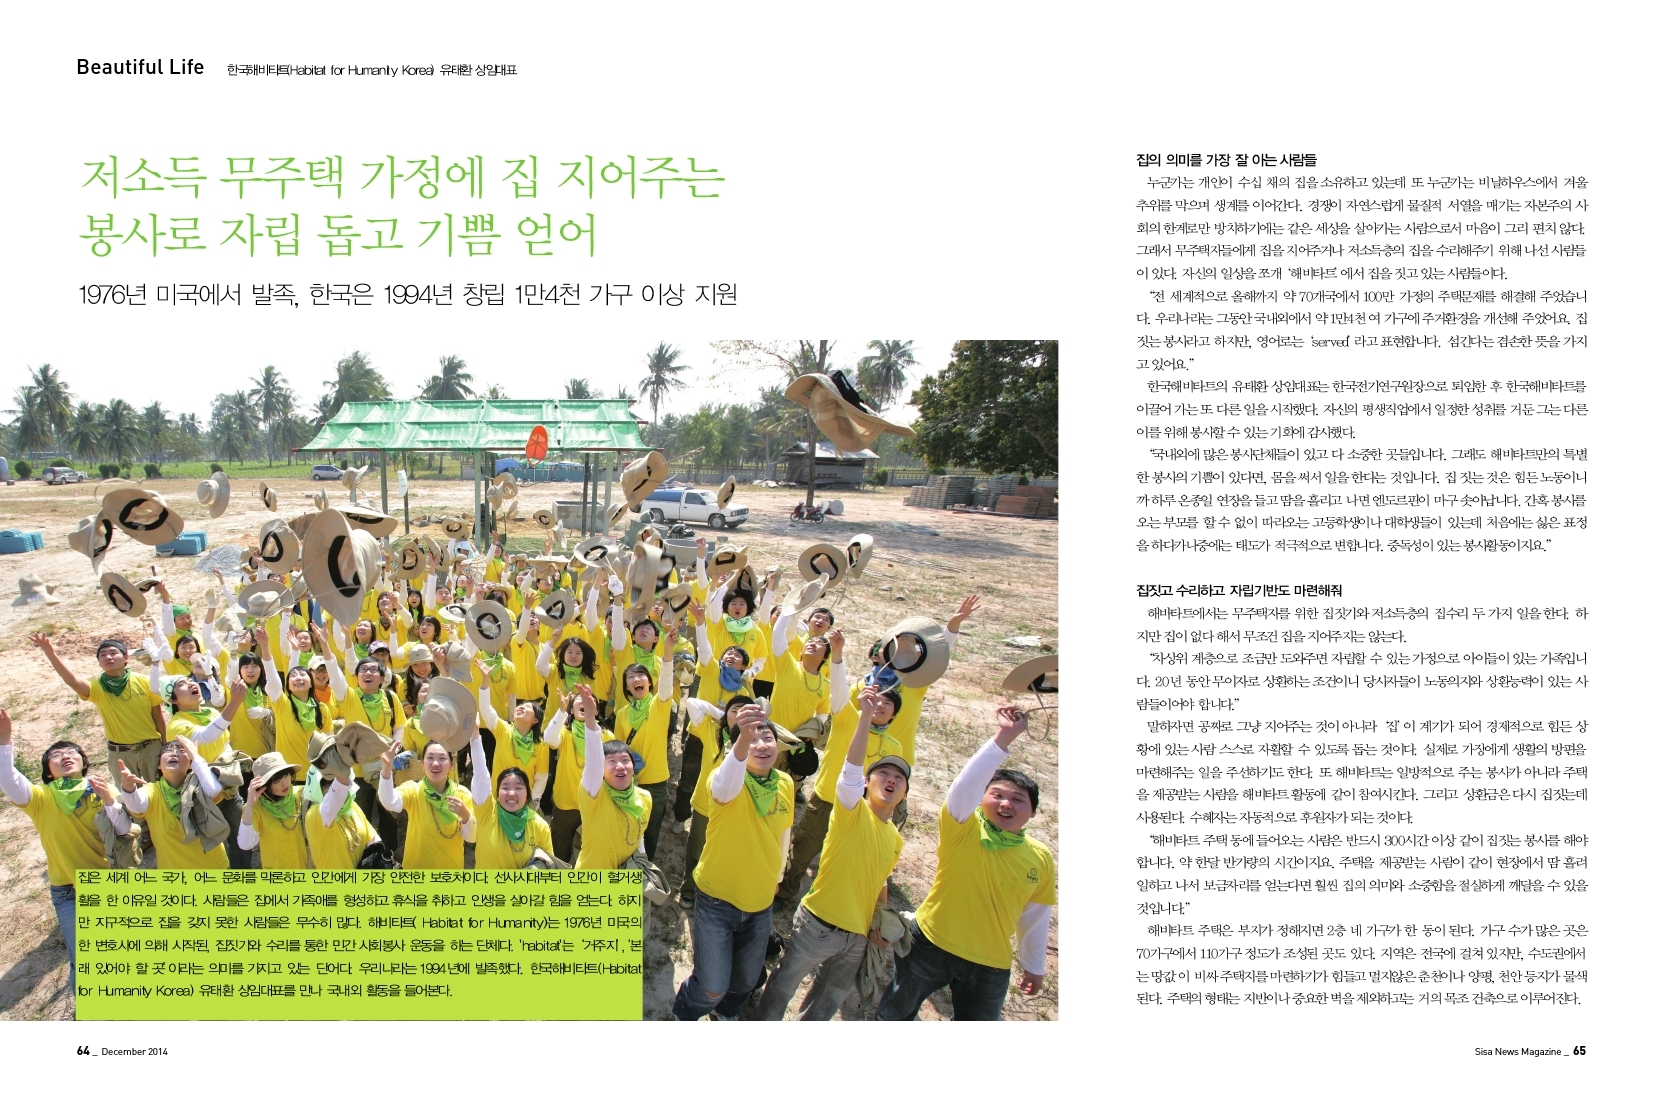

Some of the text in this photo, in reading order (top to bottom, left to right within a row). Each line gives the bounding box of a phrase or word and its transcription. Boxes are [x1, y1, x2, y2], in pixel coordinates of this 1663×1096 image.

[77, 58, 205, 75] Beautiful Life
[1136, 153, 1318, 168] 집의 의미를 가장 잘 아는 사람들
[81, 154, 726, 200] 저소득 무주택 가정에 집 지어주는
[79, 212, 595, 258] 봉사로 자립 돕고 기쁨 얻어
[79, 282, 737, 309] 1976년 미국에서 발족, 한국은 1994년 창립 1만4천 가구 이상 지원
[1136, 583, 1343, 598] 집짓고 수리하고 자립기반도 마련해줘
[78, 870, 102, 884] 집은
[105, 870, 129, 885] 세계
[134, 870, 158, 885] 어느
[161, 870, 188, 886] 국가,
[194, 870, 218, 885] 어느
[221, 871, 258, 884] 문화를
[260, 870, 307, 885] 막론하고
[311, 870, 357, 885] 인간에게
[362, 871, 387, 885] 가장
[389, 870, 426, 884] 안전한
[493, 870, 562, 885] 선사시대부터
[567, 870, 602, 885] 인간이
[607, 870, 643, 885] 혈거생
[77, 983, 453, 999] for Humanity Korea) 유태환 상임대표를 만나 국내외 활동을 들어본다.
[76, 1045, 169, 1056] 64 December 2014
[1474, 1045, 1587, 1058] Sisa News Magazine 65
